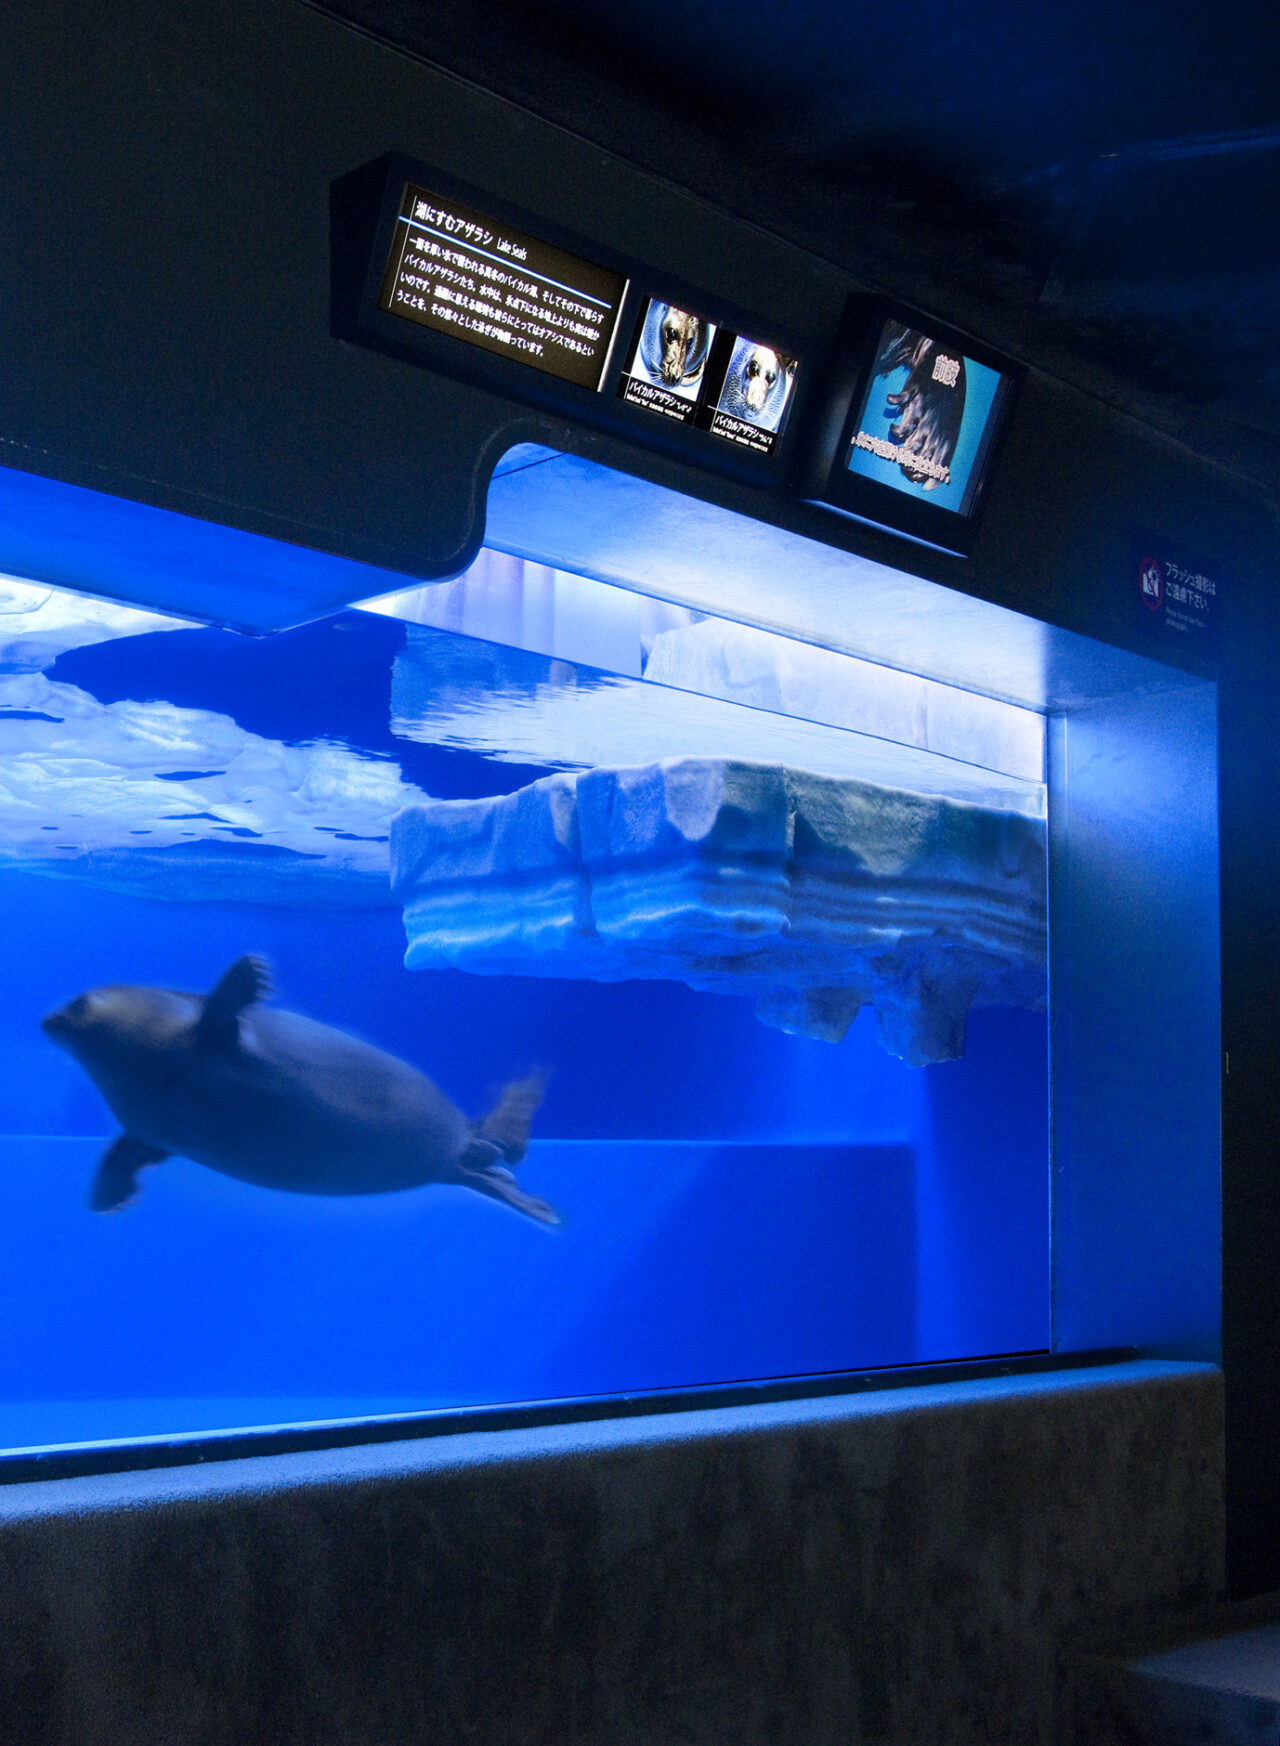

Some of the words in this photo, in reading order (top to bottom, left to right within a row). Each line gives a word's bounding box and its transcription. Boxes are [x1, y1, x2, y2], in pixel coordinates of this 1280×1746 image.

[415, 201, 493, 245] 湖にすむアザラシ
[497, 237, 511, 253] Lake
[511, 244, 528, 260] Seals
[931, 354, 960, 388] 前肢
[628, 381, 676, 406] バイカルアザラシ
[714, 414, 759, 438] バイカルアザラシ
